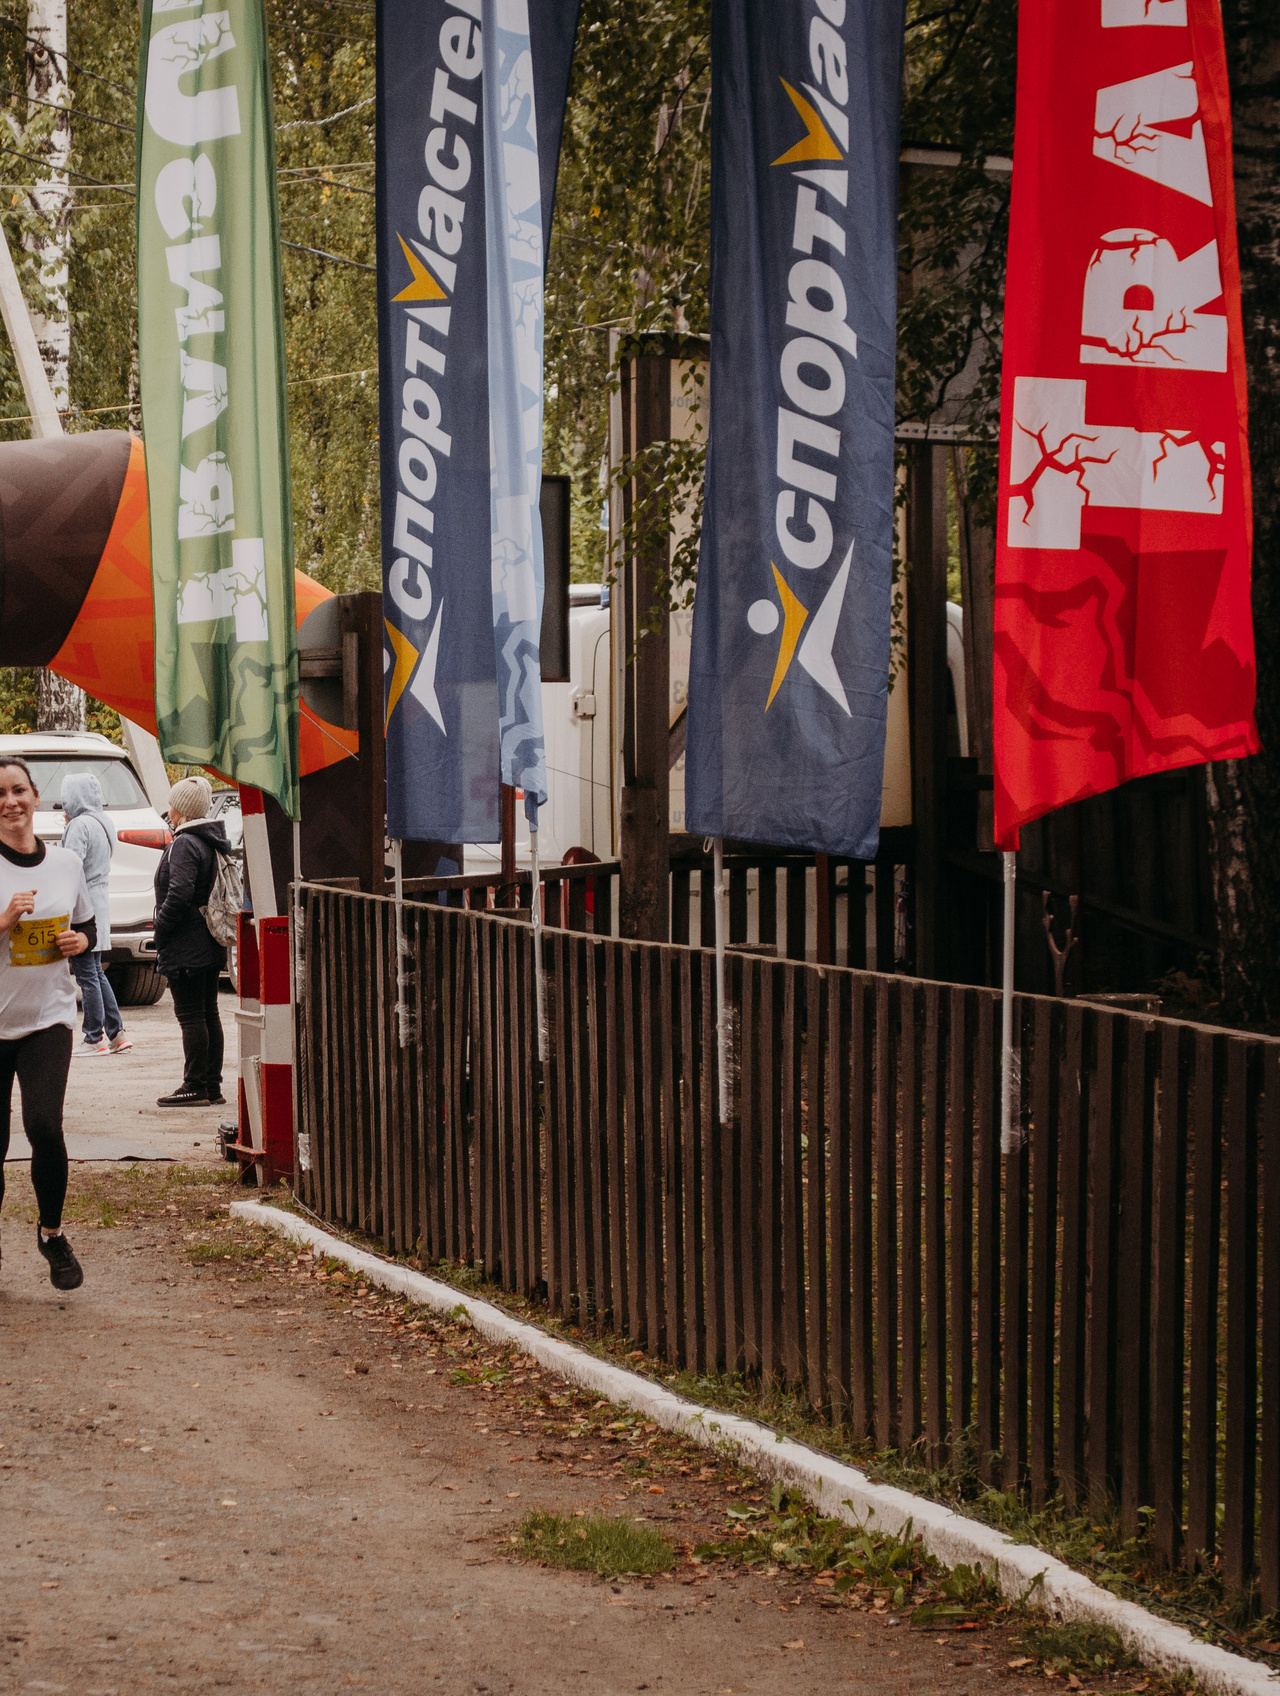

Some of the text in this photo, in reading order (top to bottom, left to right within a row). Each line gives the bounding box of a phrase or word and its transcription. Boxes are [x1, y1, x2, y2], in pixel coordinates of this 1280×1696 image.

[145, 0, 269, 643] TRANSU
[1008, 0, 1228, 550] TRA
[27, 929, 57, 946] 615
